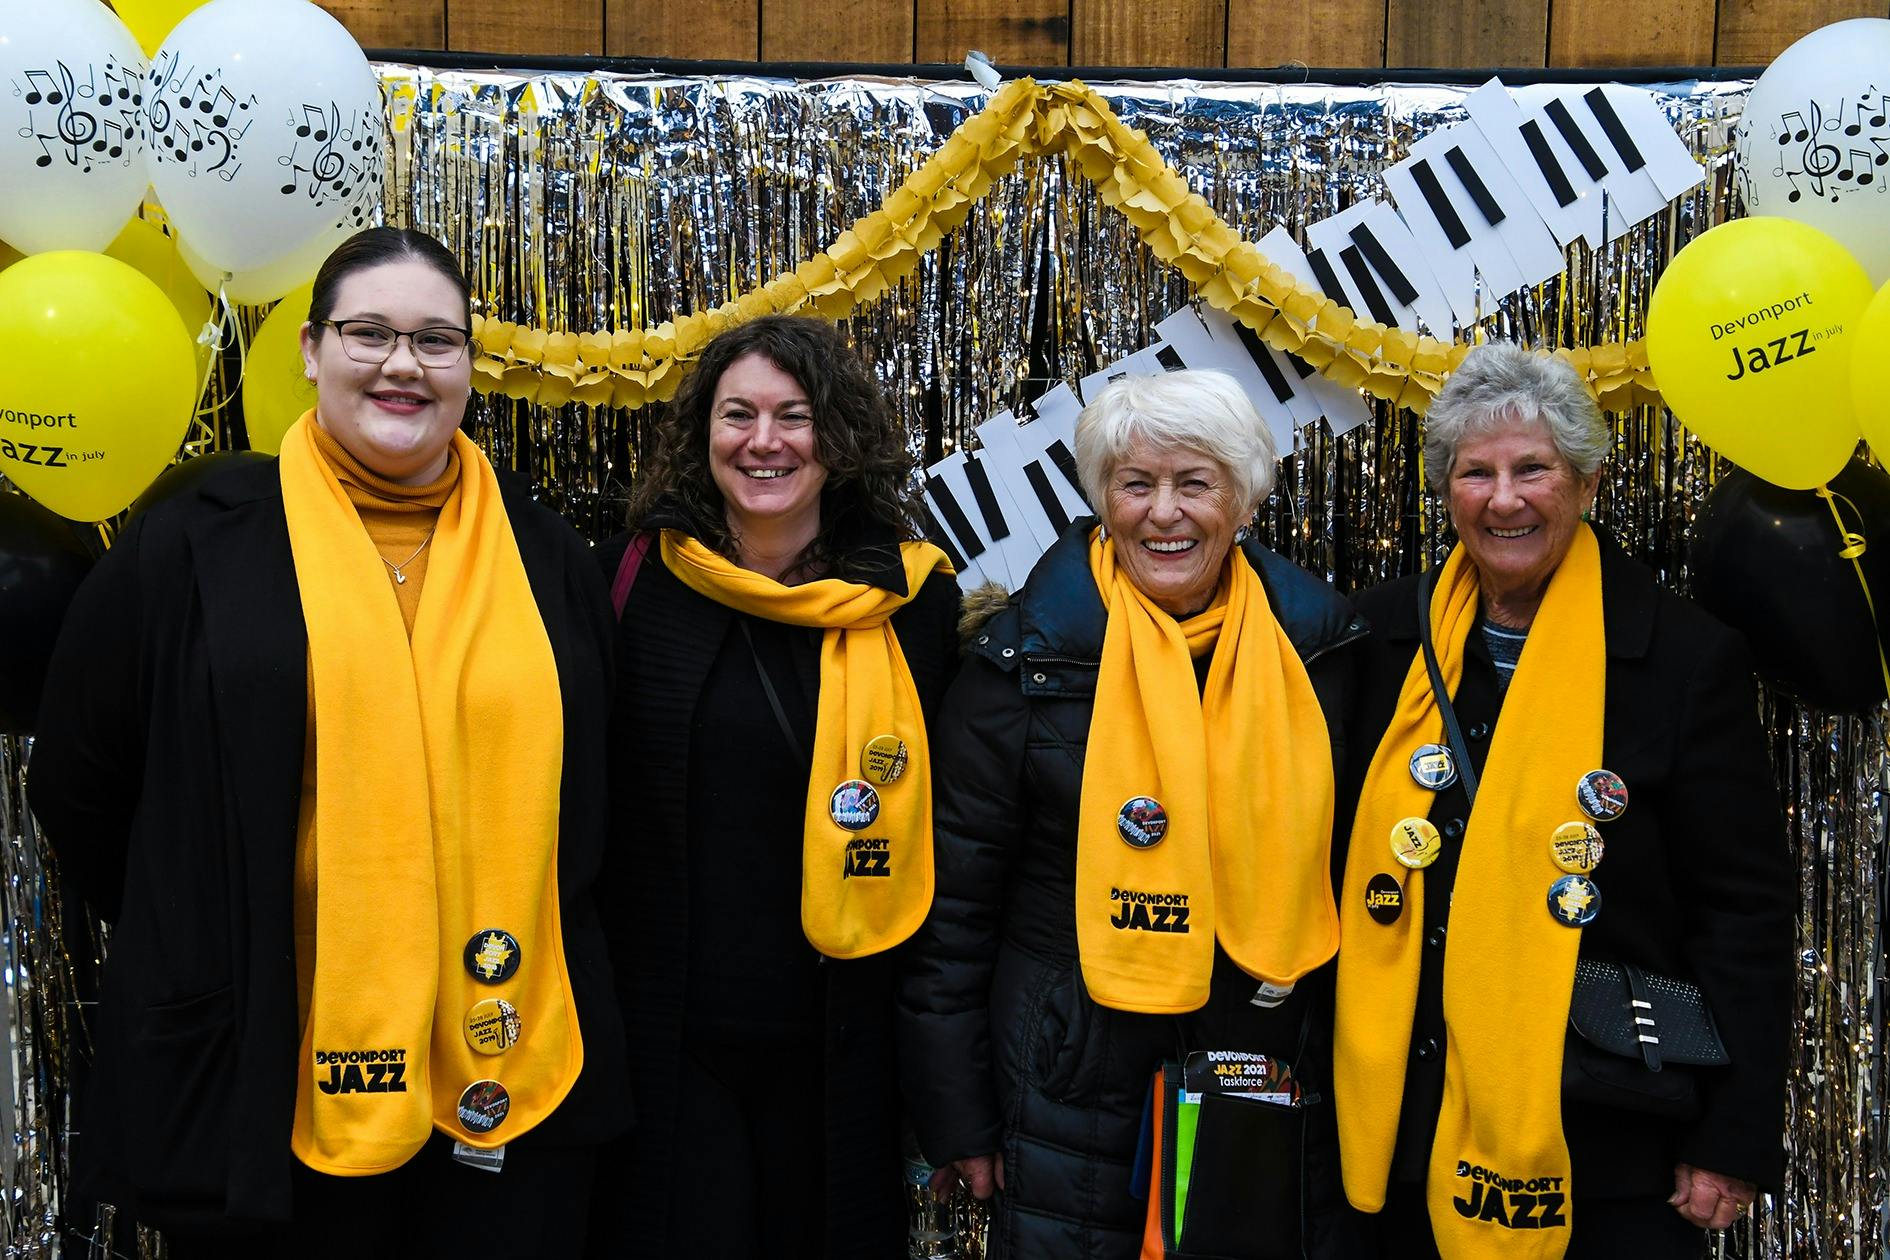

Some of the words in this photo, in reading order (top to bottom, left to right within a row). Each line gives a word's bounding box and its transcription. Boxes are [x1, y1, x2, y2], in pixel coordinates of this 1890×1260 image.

[1710, 292, 1813, 340] Devonport
[1727, 328, 1816, 381] Jazz
[1812, 331, 1823, 341] in
[1825, 324, 1843, 339] july
[0, 408, 77, 430] onport
[0, 438, 67, 468] azz
[66, 452, 78, 461] in
[82, 450, 105, 462] july
[1404, 826, 1422, 849] JAZZ
[1367, 890, 1400, 906] Jazz
[1110, 902, 1190, 933] JAZZ
[474, 1028, 493, 1038] JAZZ
[479, 1034, 496, 1045] 2019
[318, 1063, 407, 1095] JAZZ
[1214, 1064, 1243, 1076] JAZZ
[1243, 1064, 1267, 1075] 2021
[1219, 1076, 1263, 1087] Taskforce
[1453, 1181, 1567, 1230] JAZZ
